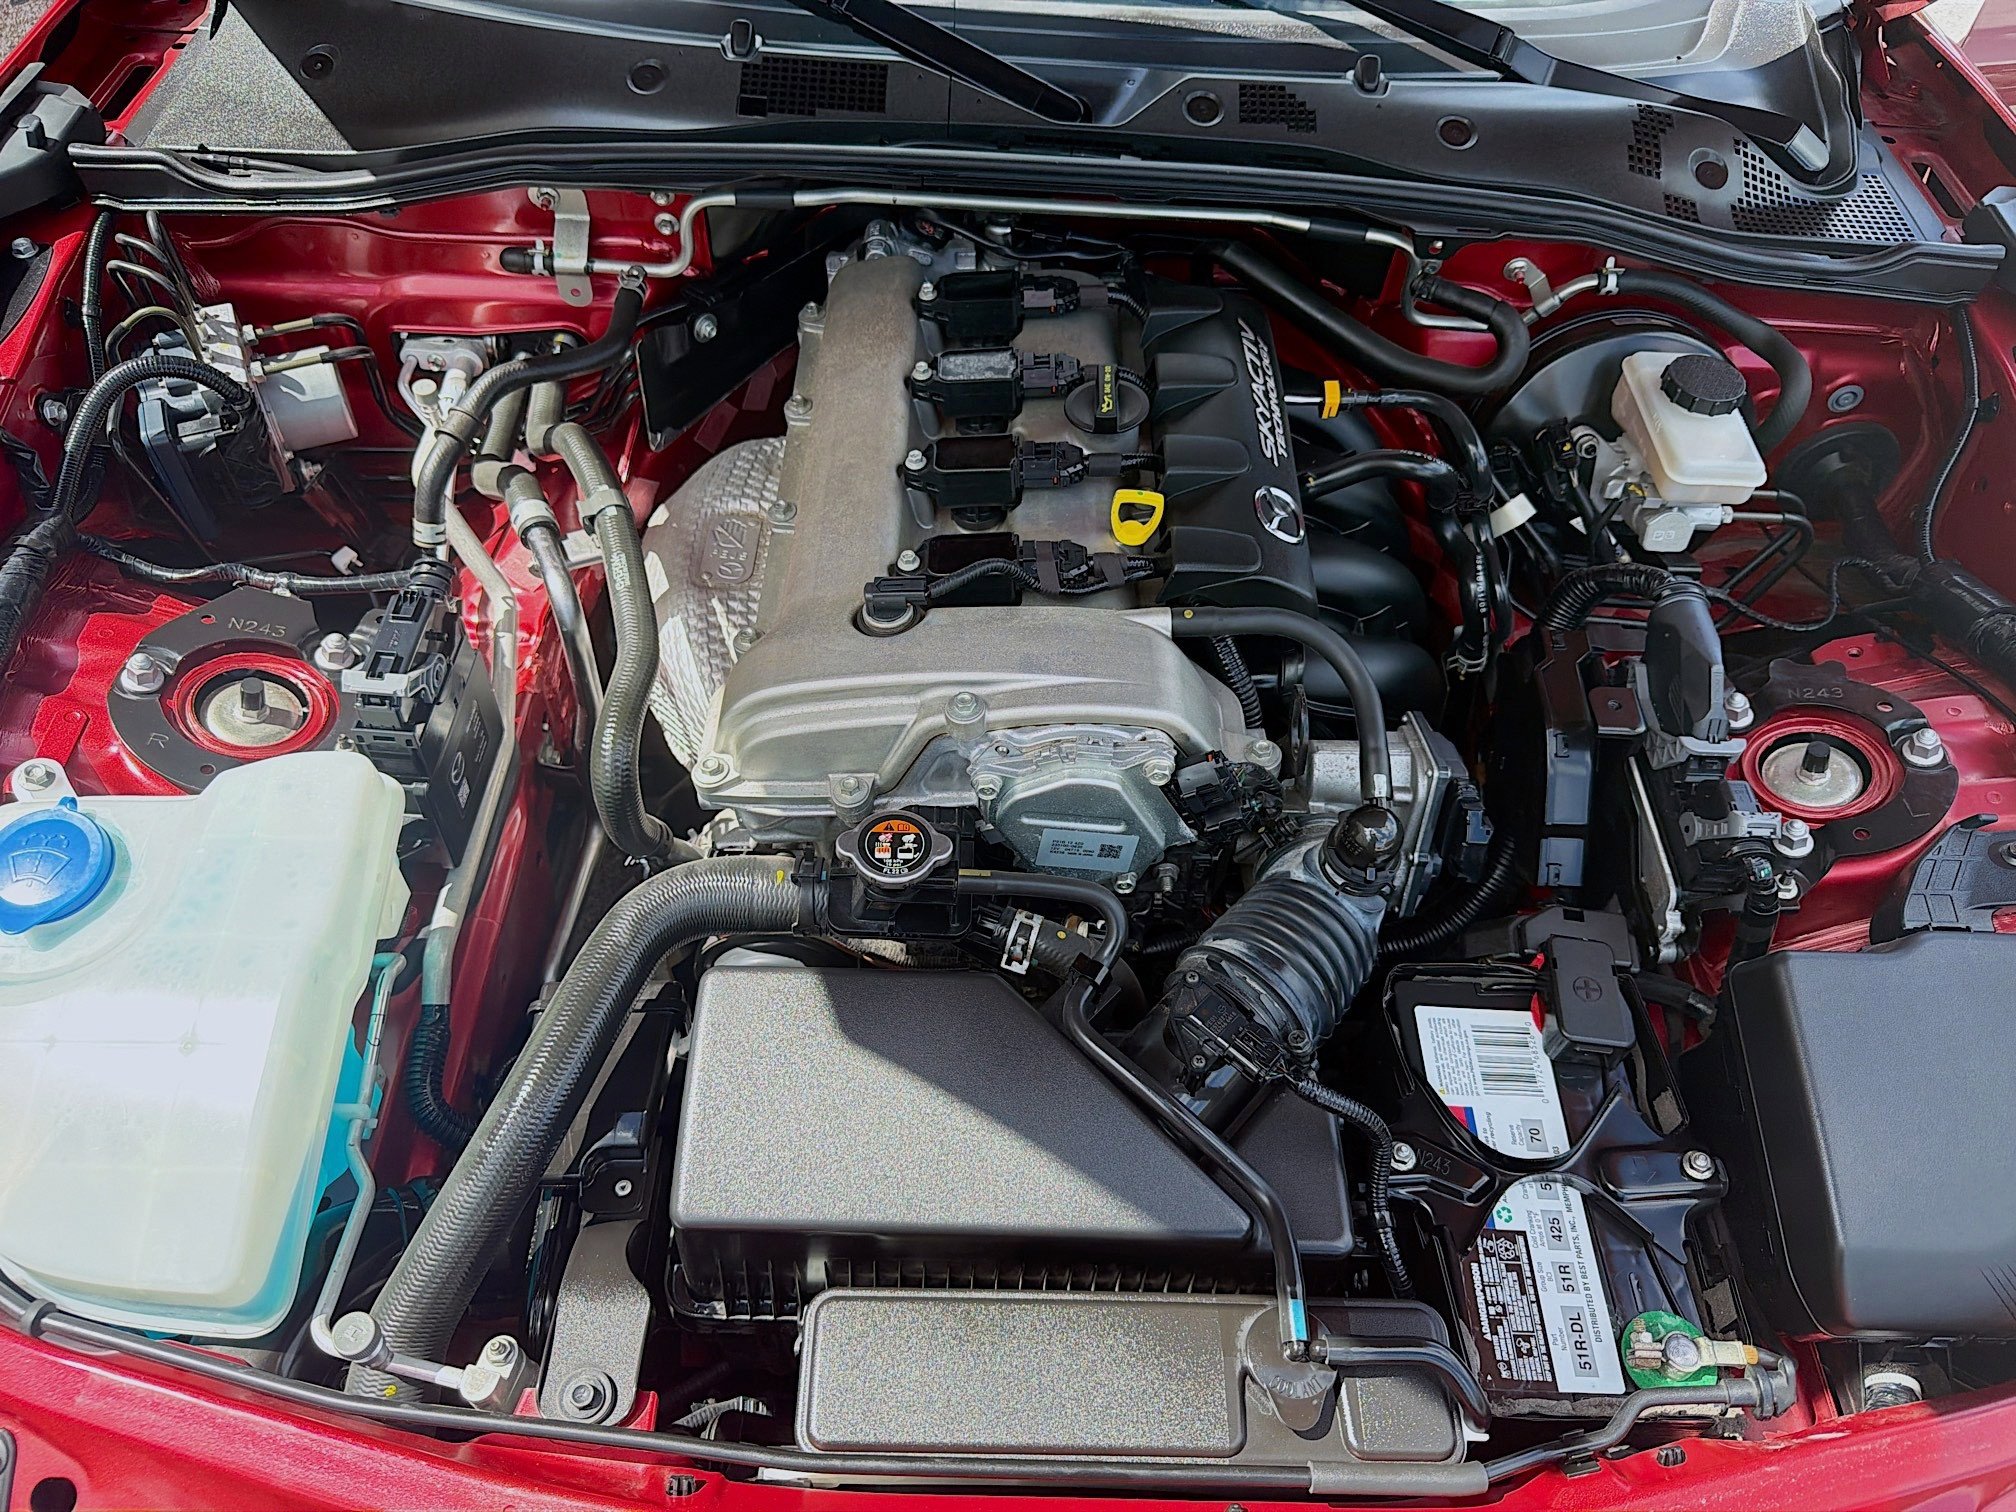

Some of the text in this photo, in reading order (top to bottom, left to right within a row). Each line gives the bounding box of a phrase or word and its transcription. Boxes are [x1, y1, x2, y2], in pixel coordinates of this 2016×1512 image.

[1238, 317, 1279, 467] SKYACTIV
[1257, 335, 1288, 458] TECHNOLOGY
[228, 617, 287, 637] N243
[1787, 687, 1844, 699] N243
[147, 733, 170, 748] R
[1508, 1124, 1517, 1144] Reserve
[1515, 1124, 1524, 1145] Capacity
[1528, 1128, 1541, 1143] 70
[1417, 1148, 1450, 1175] N243
[1525, 1209, 1539, 1248] Cold Cranking
[1548, 1216, 1563, 1242] 425
[1568, 1216, 1578, 1232] INC.,
[1537, 1231, 1546, 1247] Amps
[1571, 1233, 1584, 1258] PARTS,
[1535, 1261, 1548, 1292] Group Size
[1557, 1264, 1575, 1292] 51R
[1577, 1260, 1588, 1279] BEST
[1470, 1262, 1490, 1333] DANGER/POISON
[1582, 1281, 1591, 1291] BY
[1584, 1293, 1602, 1342] DISTRIBUTED
[1550, 1332, 1559, 1345] Part
[1556, 1326, 1568, 1350] Number
[1567, 1311, 1592, 1370] 51R-DL
